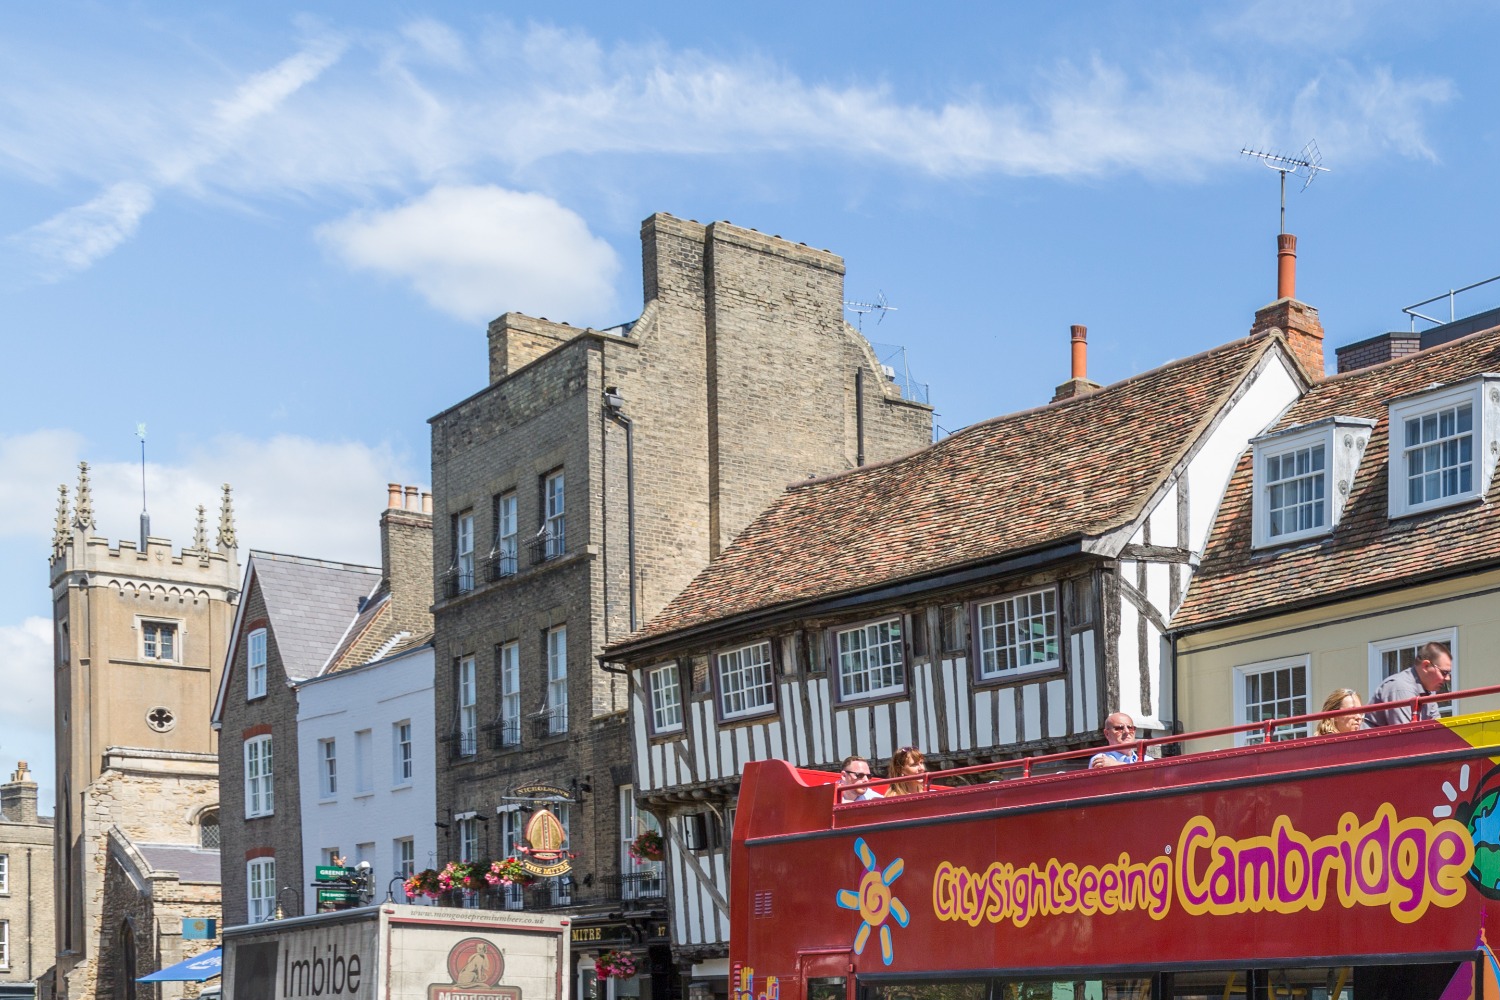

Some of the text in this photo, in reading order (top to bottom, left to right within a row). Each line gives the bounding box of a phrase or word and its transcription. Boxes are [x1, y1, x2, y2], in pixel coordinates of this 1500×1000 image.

[524, 861, 571, 875] THE MITRE
[934, 803, 1474, 926] CitySightseeing Cambridge
[410, 909, 545, 925] www.mongoosepremiumbeer.co.uk
[572, 927, 601, 941] MITRE
[657, 926, 666, 937] 17
[283, 944, 361, 998] Imbibe
